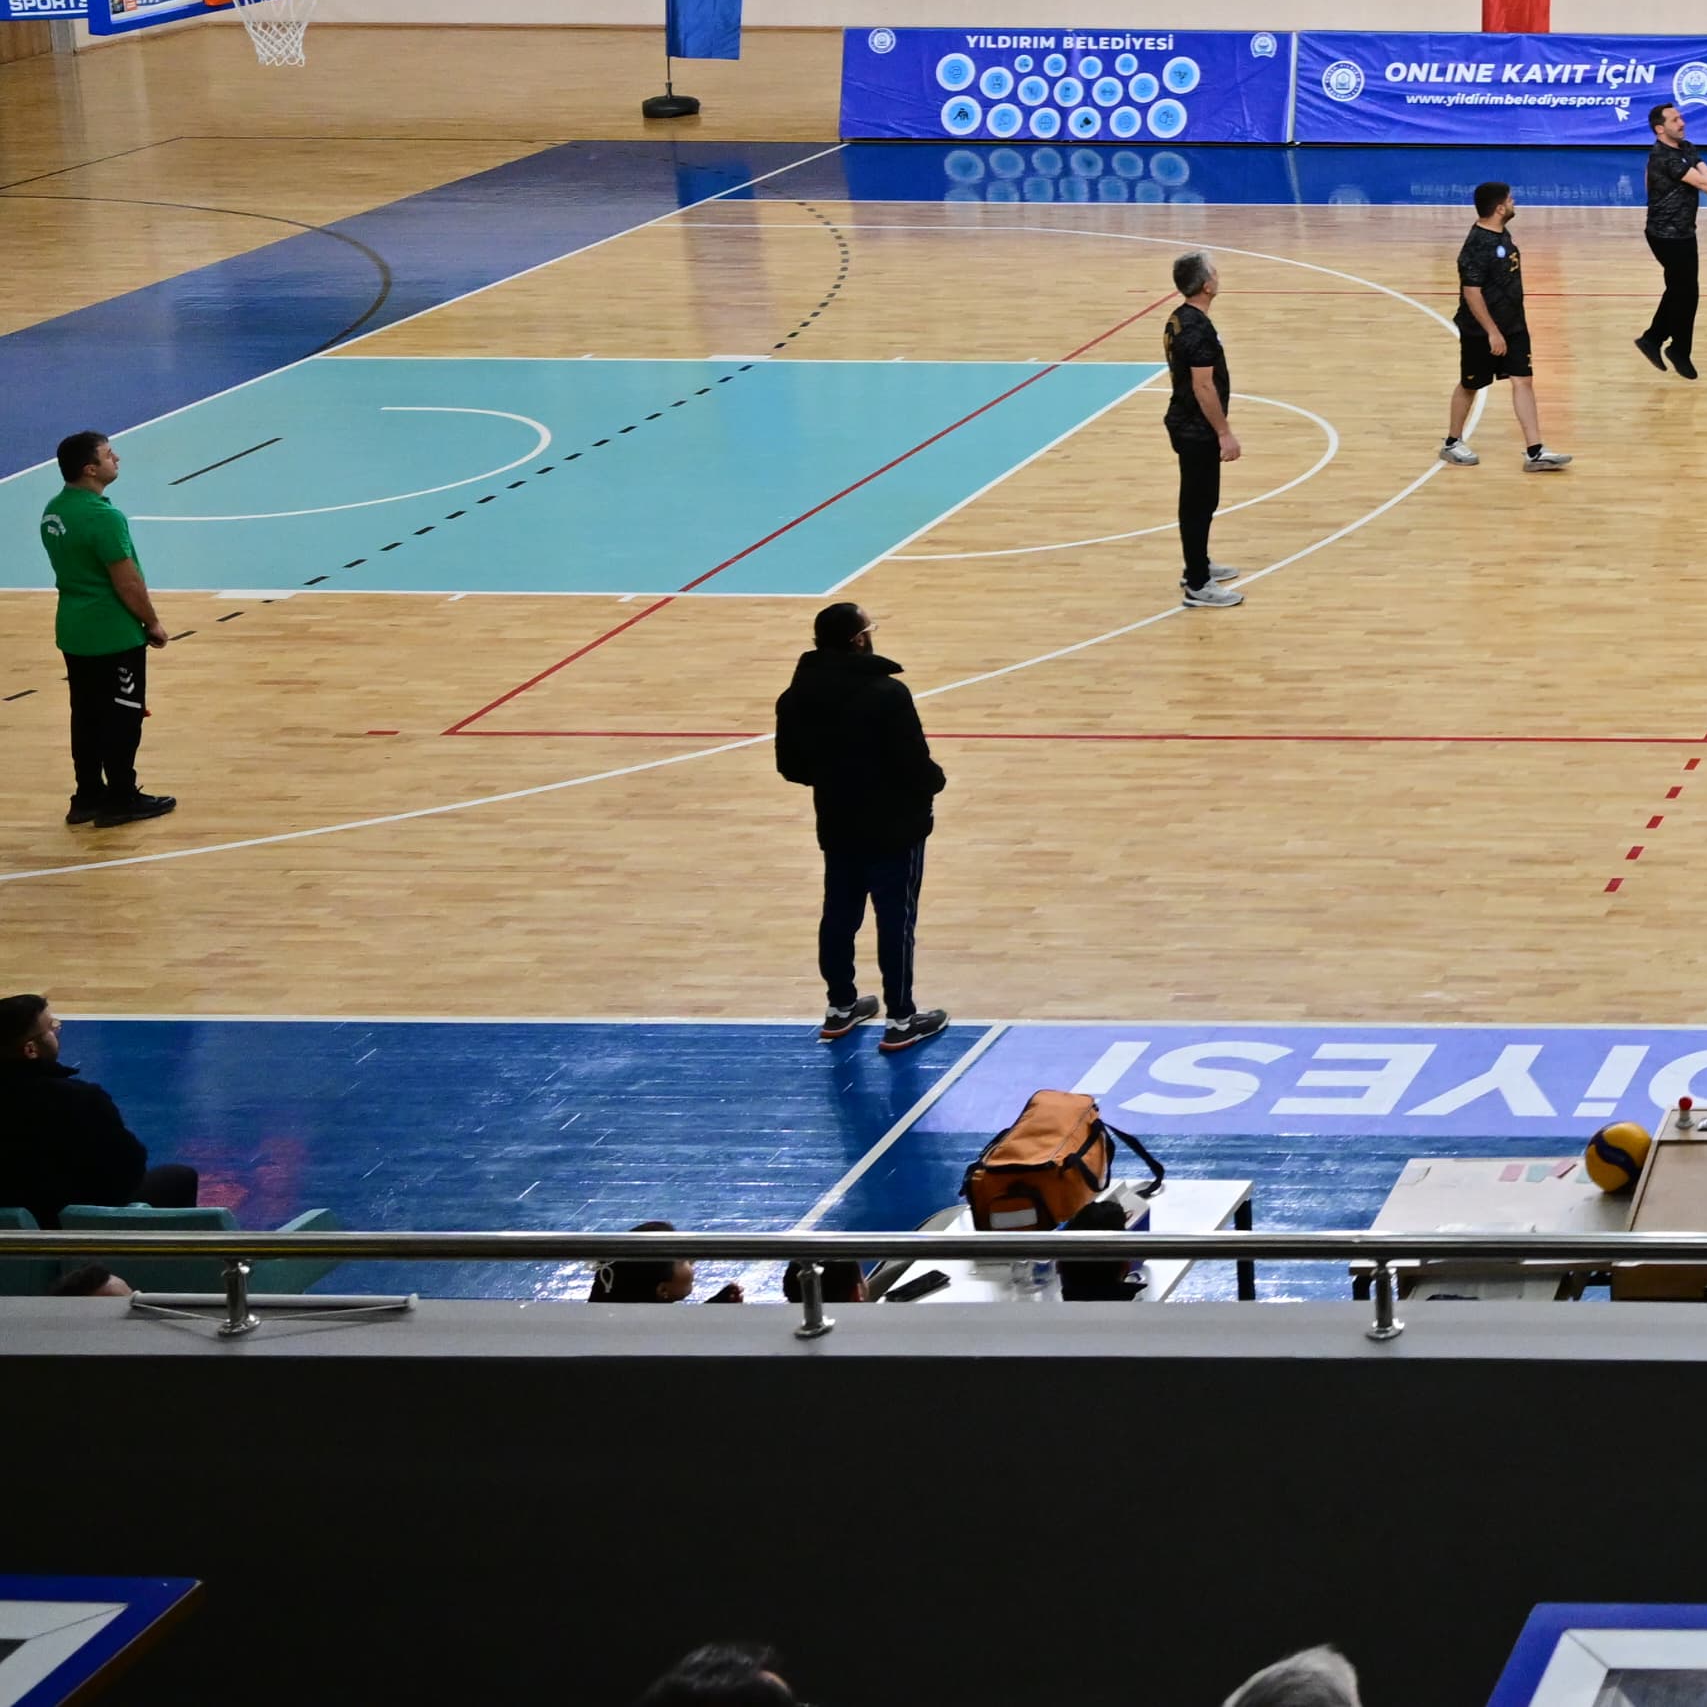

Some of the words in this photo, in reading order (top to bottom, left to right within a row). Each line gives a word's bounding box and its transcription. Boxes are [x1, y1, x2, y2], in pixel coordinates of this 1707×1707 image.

[966, 34, 1056, 50] YILDIRIM
[1063, 32, 1175, 51] BELEDİYESİ
[1384, 62, 1498, 84] ONLINE
[1501, 63, 1590, 85] KAYIT
[1596, 57, 1657, 91] İÇİN
[1405, 91, 1631, 109] www.yildirimbelediyespor.org
